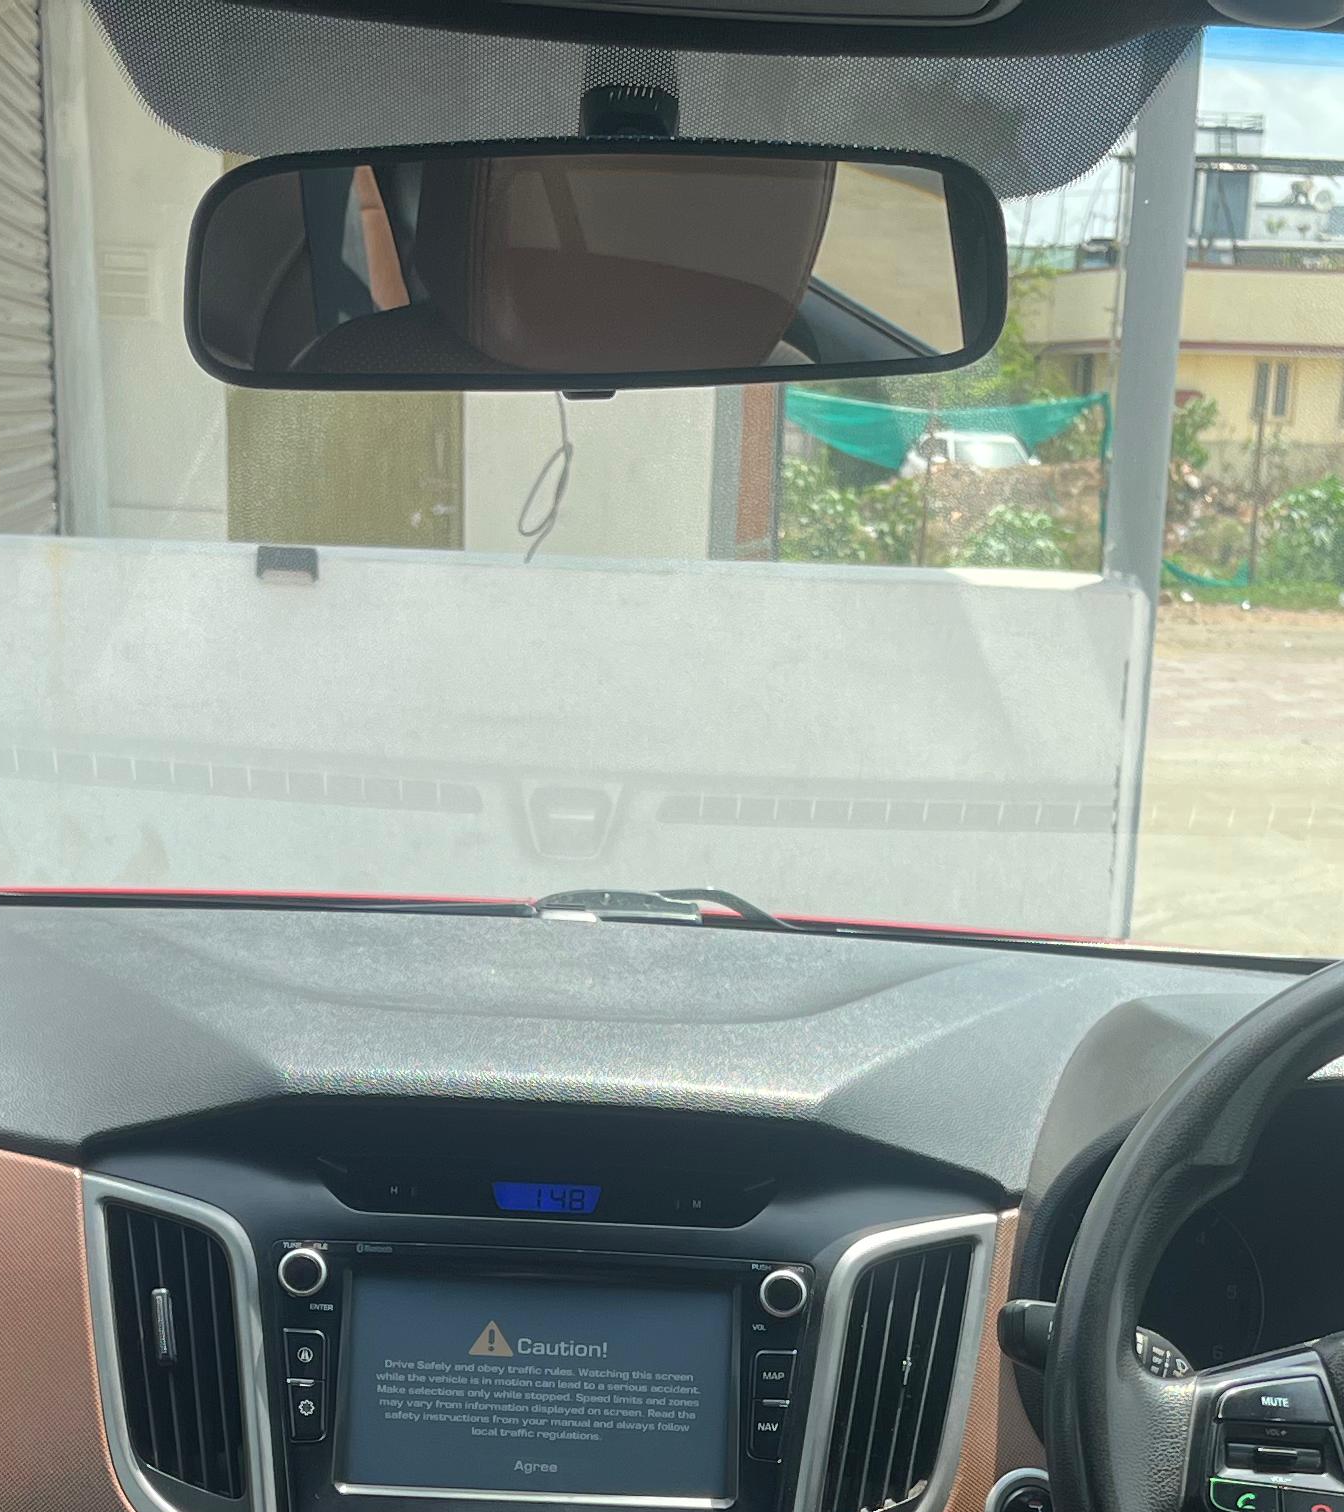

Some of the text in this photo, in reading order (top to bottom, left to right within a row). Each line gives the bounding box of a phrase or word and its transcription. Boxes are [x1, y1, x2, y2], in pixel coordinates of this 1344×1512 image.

[309, 1302, 334, 1311] ENTER
[517, 1337, 608, 1359] Caution!
[384, 1359, 415, 1370] Drive
[417, 1360, 451, 1373] Safely
[454, 1362, 475, 1372] and
[478, 1363, 505, 1376] obey
[507, 1365, 543, 1376] traffic
[578, 1368, 630, 1381] Watching
[631, 1369, 653, 1380] this
[654, 1372, 694, 1383] screen
[762, 1371, 785, 1380] MAP
[376, 1372, 406, 1382] while
[407, 1373, 426, 1383] the
[428, 1374, 468, 1385] vehicle
[470, 1376, 479, 1385] is
[481, 1376, 492, 1385] in
[494, 1377, 532, 1388] motion
[534, 1380, 555, 1388] can
[557, 1380, 581, 1389] lead
[583, 1381, 595, 1390] to
[607, 1382, 647, 1393] serious
[376, 1384, 406, 1394] Make
[408, 1386, 465, 1397] selections
[467, 1388, 490, 1400] only
[493, 1390, 522, 1400] while
[575, 1393, 610, 1404] Speed
[613, 1394, 643, 1405] limits
[645, 1397, 666, 1406] and
[668, 1399, 700, 1408] zones
[1260, 1396, 1289, 1408] MUTE
[379, 1399, 404, 1409] may
[406, 1400, 433, 1411] vary
[435, 1399, 462, 1410] from
[465, 1401, 529, 1413] information
[531, 1404, 584, 1416] displayed
[587, 1407, 601, 1415] on
[647, 1408, 676, 1419] Read
[384, 1410, 690, 1433] safety instructions from your manual and always follow
[757, 1422, 779, 1432] NAV
[471, 1426, 498, 1437] local
[500, 1427, 535, 1438] traffic
[513, 1459, 558, 1475] Agree
